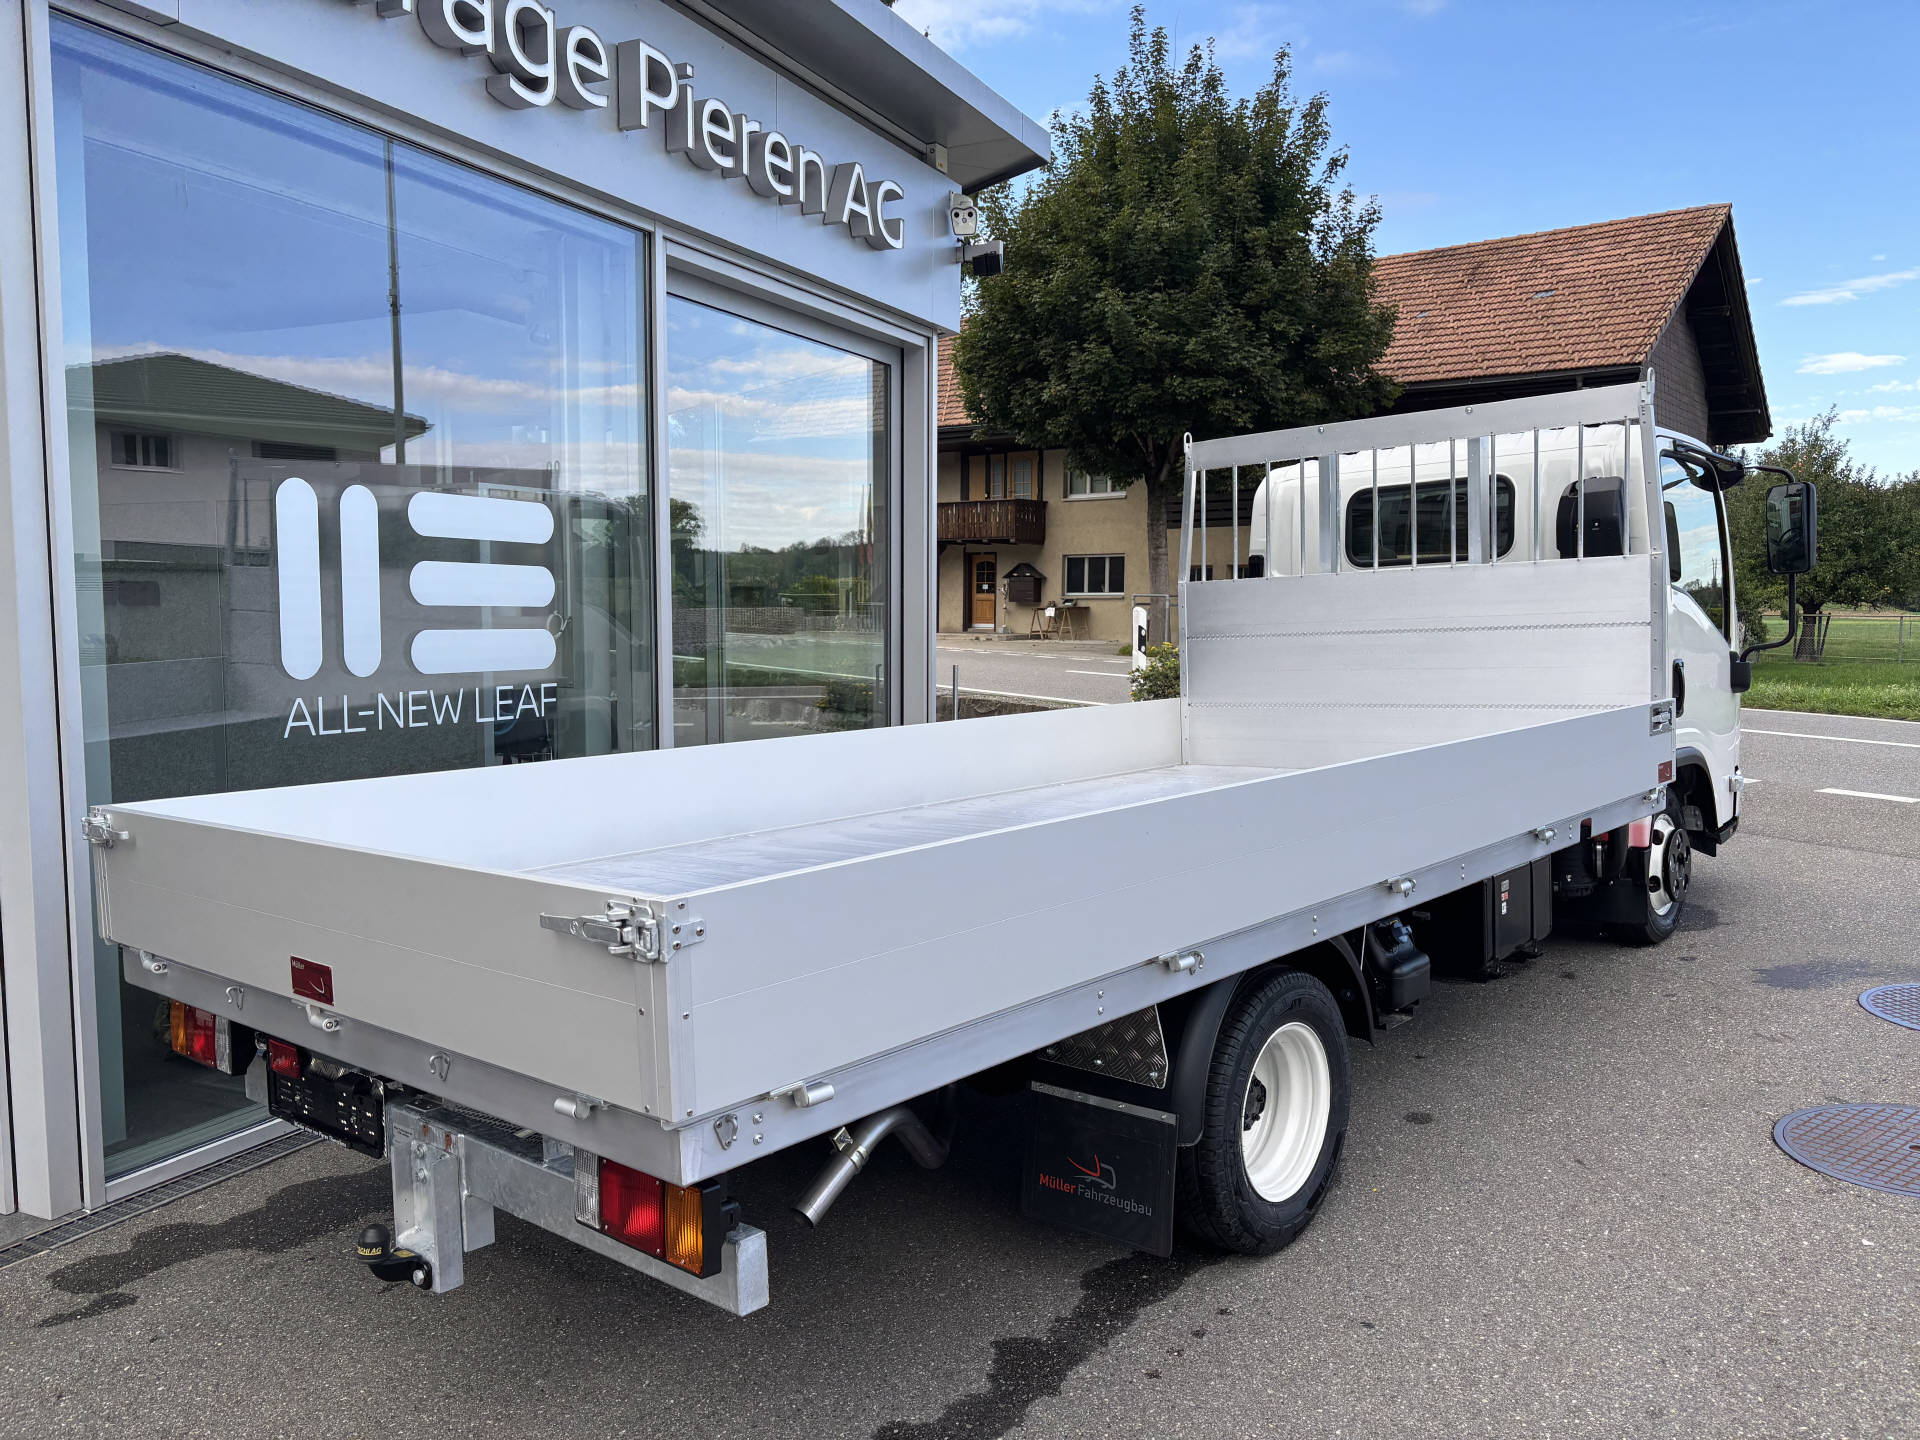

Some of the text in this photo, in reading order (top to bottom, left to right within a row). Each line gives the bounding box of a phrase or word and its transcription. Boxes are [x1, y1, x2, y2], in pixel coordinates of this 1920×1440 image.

[402, 0, 905, 249] age Pieren AG
[284, 683, 558, 739] ALL-NEW LEAF
[1039, 1172, 1152, 1216] Müller Fahrzeugbau
